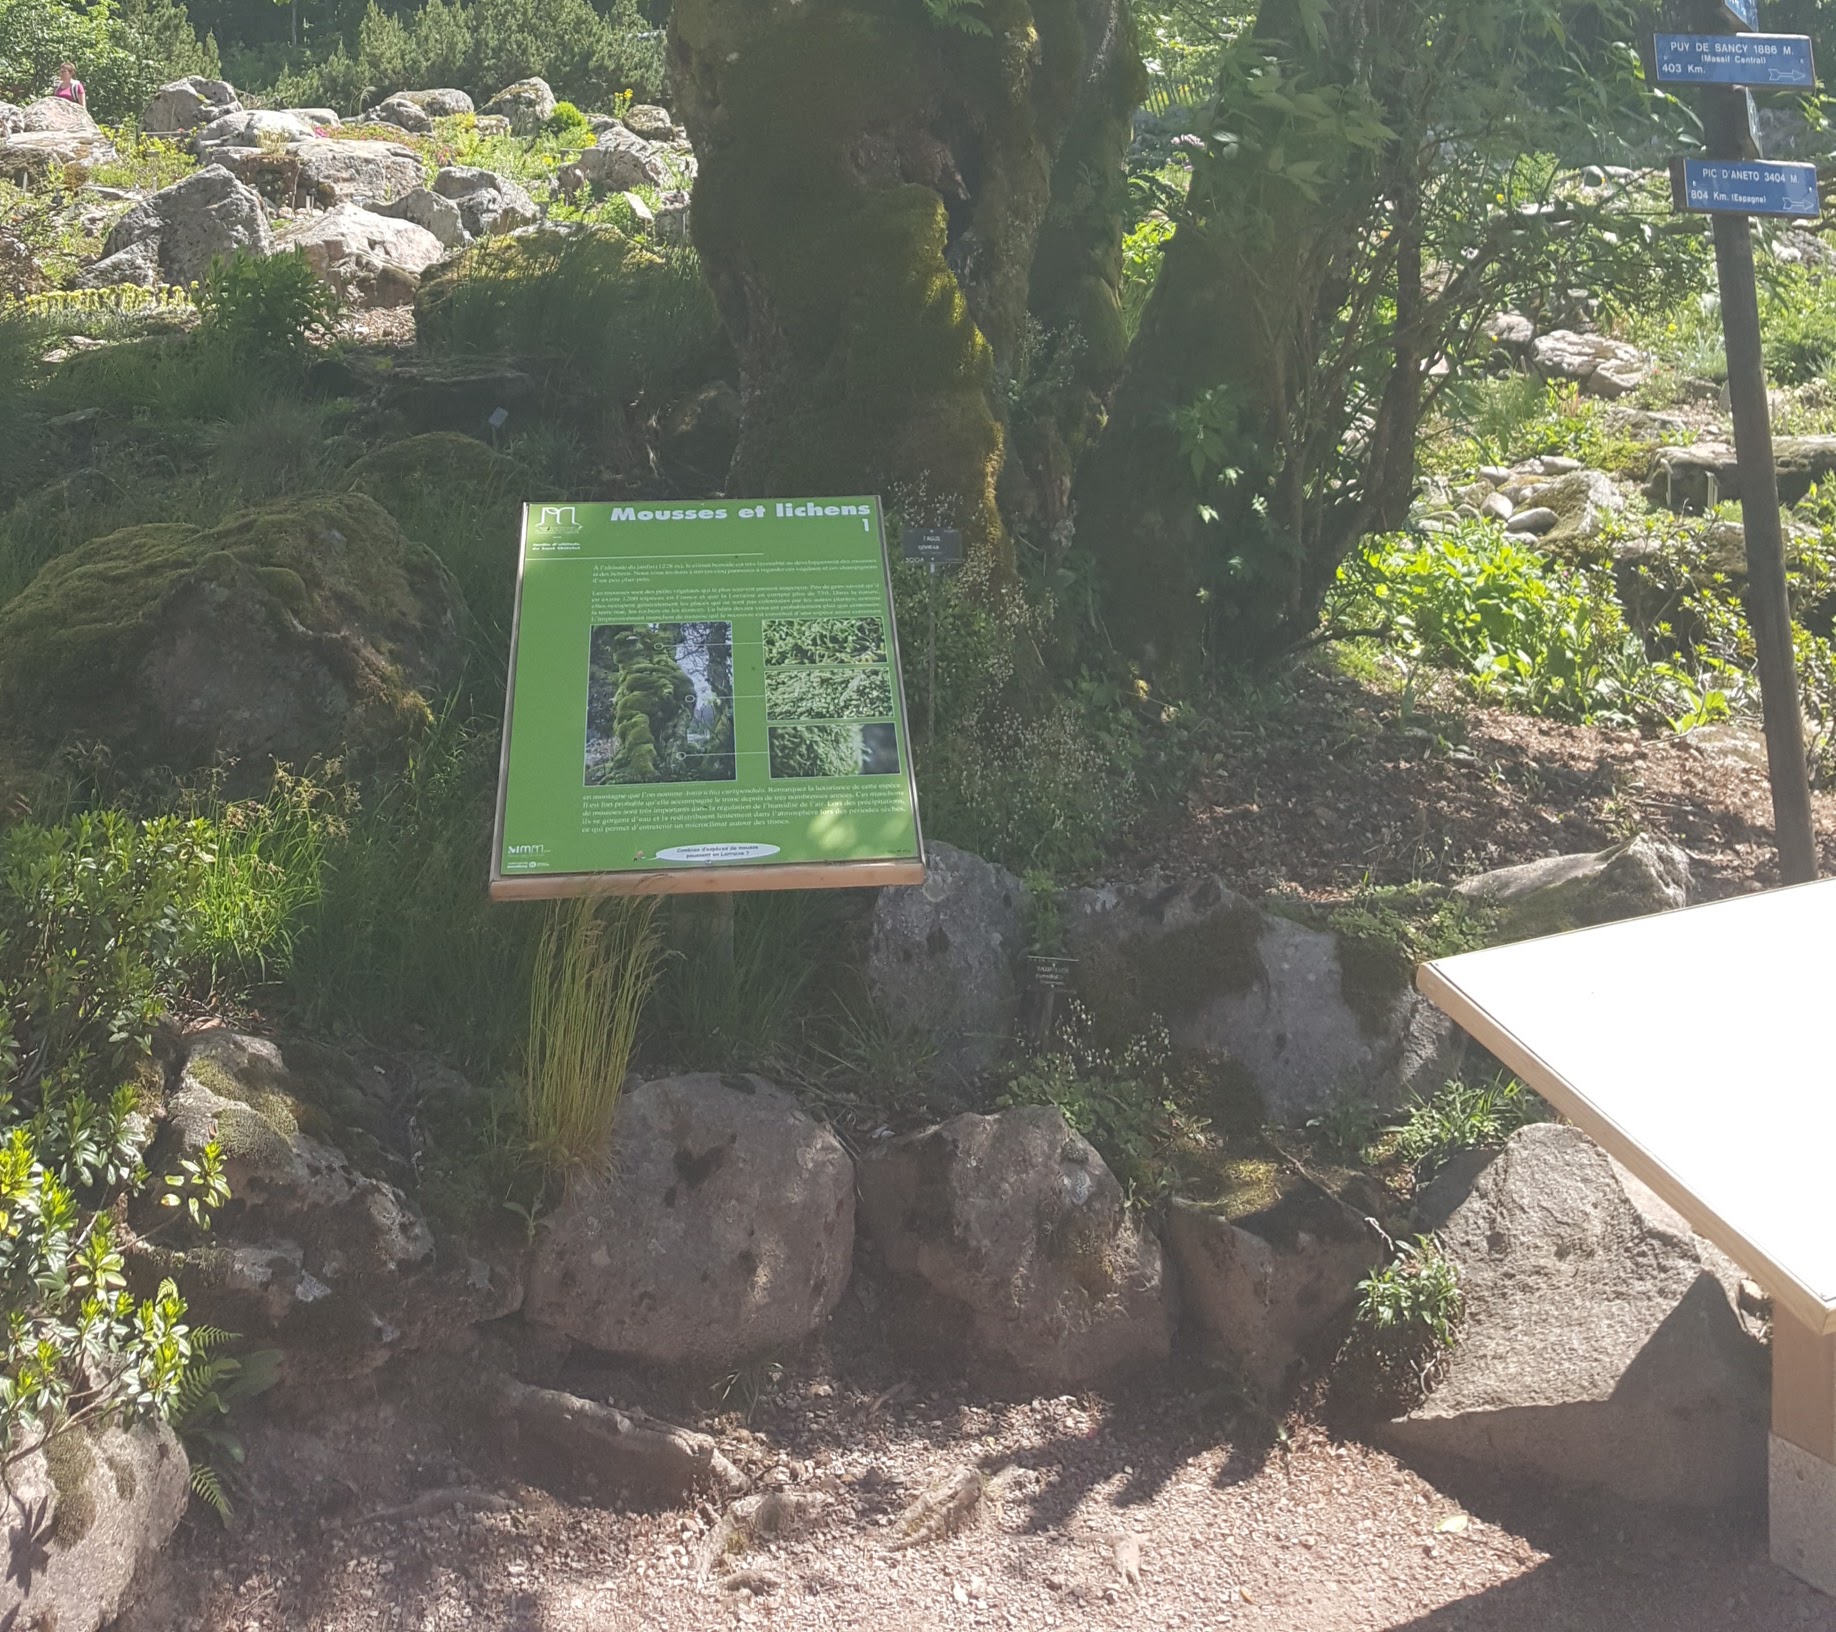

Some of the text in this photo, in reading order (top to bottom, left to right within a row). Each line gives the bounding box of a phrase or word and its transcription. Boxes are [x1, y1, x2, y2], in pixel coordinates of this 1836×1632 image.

[1671, 42, 1794, 55] PUY DE SANCY 1886 M.
[1701, 55, 1766, 65] (Massif Central)
[1662, 63, 1706, 74] 403 Km.
[1702, 168, 1800, 184] PIC D'ANETO 3404 M.
[1691, 190, 1767, 204] 804 Km. (Espagne)
[610, 502, 871, 521] Mousses et lichens
[862, 518, 870, 532] 1
[615, 800, 644, 808] probable
[654, 806, 690, 815] importants
[602, 817, 629, 825] gorgent
[670, 813, 715, 821] redistribuent
[605, 825, 630, 833] permet
